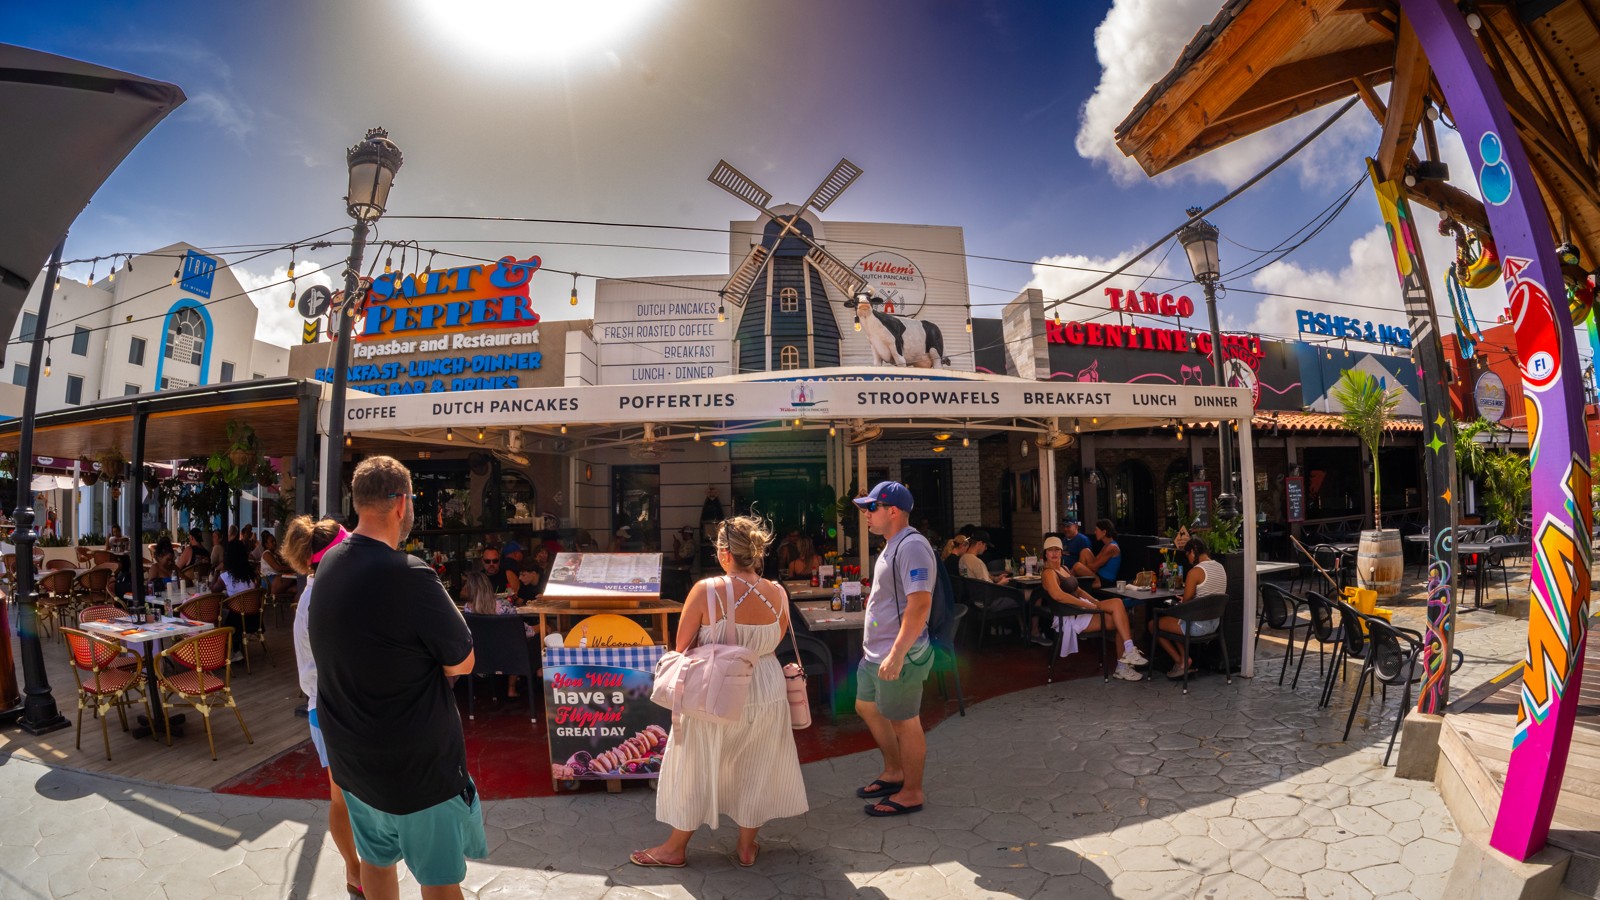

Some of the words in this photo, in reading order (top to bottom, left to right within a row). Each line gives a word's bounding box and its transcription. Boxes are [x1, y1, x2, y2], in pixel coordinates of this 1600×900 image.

[188, 257, 214, 279] TRYP
[859, 261, 915, 275] Willem's
[370, 264, 483, 304] SALT
[490, 255, 540, 288] &
[637, 304, 665, 316] DUTCH
[669, 302, 716, 314] PANCAKES
[1104, 287, 1195, 318] TANGO
[362, 296, 537, 336] PEPPER
[1296, 309, 1362, 341] FISHES
[1364, 320, 1377, 342] &
[604, 326, 634, 339] FRESH
[636, 325, 675, 338] ROASTED
[679, 324, 715, 336] COFFEE
[1046, 319, 1190, 353] RGENTINE
[353, 338, 417, 360] Tapasbar
[419, 336, 449, 352] and
[452, 329, 539, 349] Restaurant
[664, 345, 715, 359] BREAKFAST
[315, 362, 400, 382] BRAKFAST
[408, 357, 465, 377] LUNCH
[471, 352, 542, 373] DINNER
[1222, 345, 1257, 369] ANGO
[1534, 357, 1546, 372] FI
[632, 368, 665, 381] LUNCH
[675, 366, 714, 379] DINNER
[390, 381, 425, 395] BAR
[430, 379, 445, 394] &
[451, 376, 519, 391] DRINKS
[348, 406, 397, 420] COFFEE
[432, 401, 484, 415] DUTCH
[490, 398, 579, 413] PANCAKES
[619, 393, 735, 409] POFFERTJES
[857, 392, 1000, 405] STROOPWAFELS
[1024, 392, 1111, 405] BREAKFAST
[1133, 394, 1177, 406] LUNCH
[1194, 396, 1238, 407] DINNER
[592, 635, 644, 648] Welcome!
[551, 672, 583, 689] You
[586, 672, 625, 687] Will
[553, 688, 605, 705] have
[612, 691, 624, 704] a
[555, 706, 625, 727] Flippin'
[556, 727, 597, 737] GREAT
[601, 727, 626, 736] DAY
